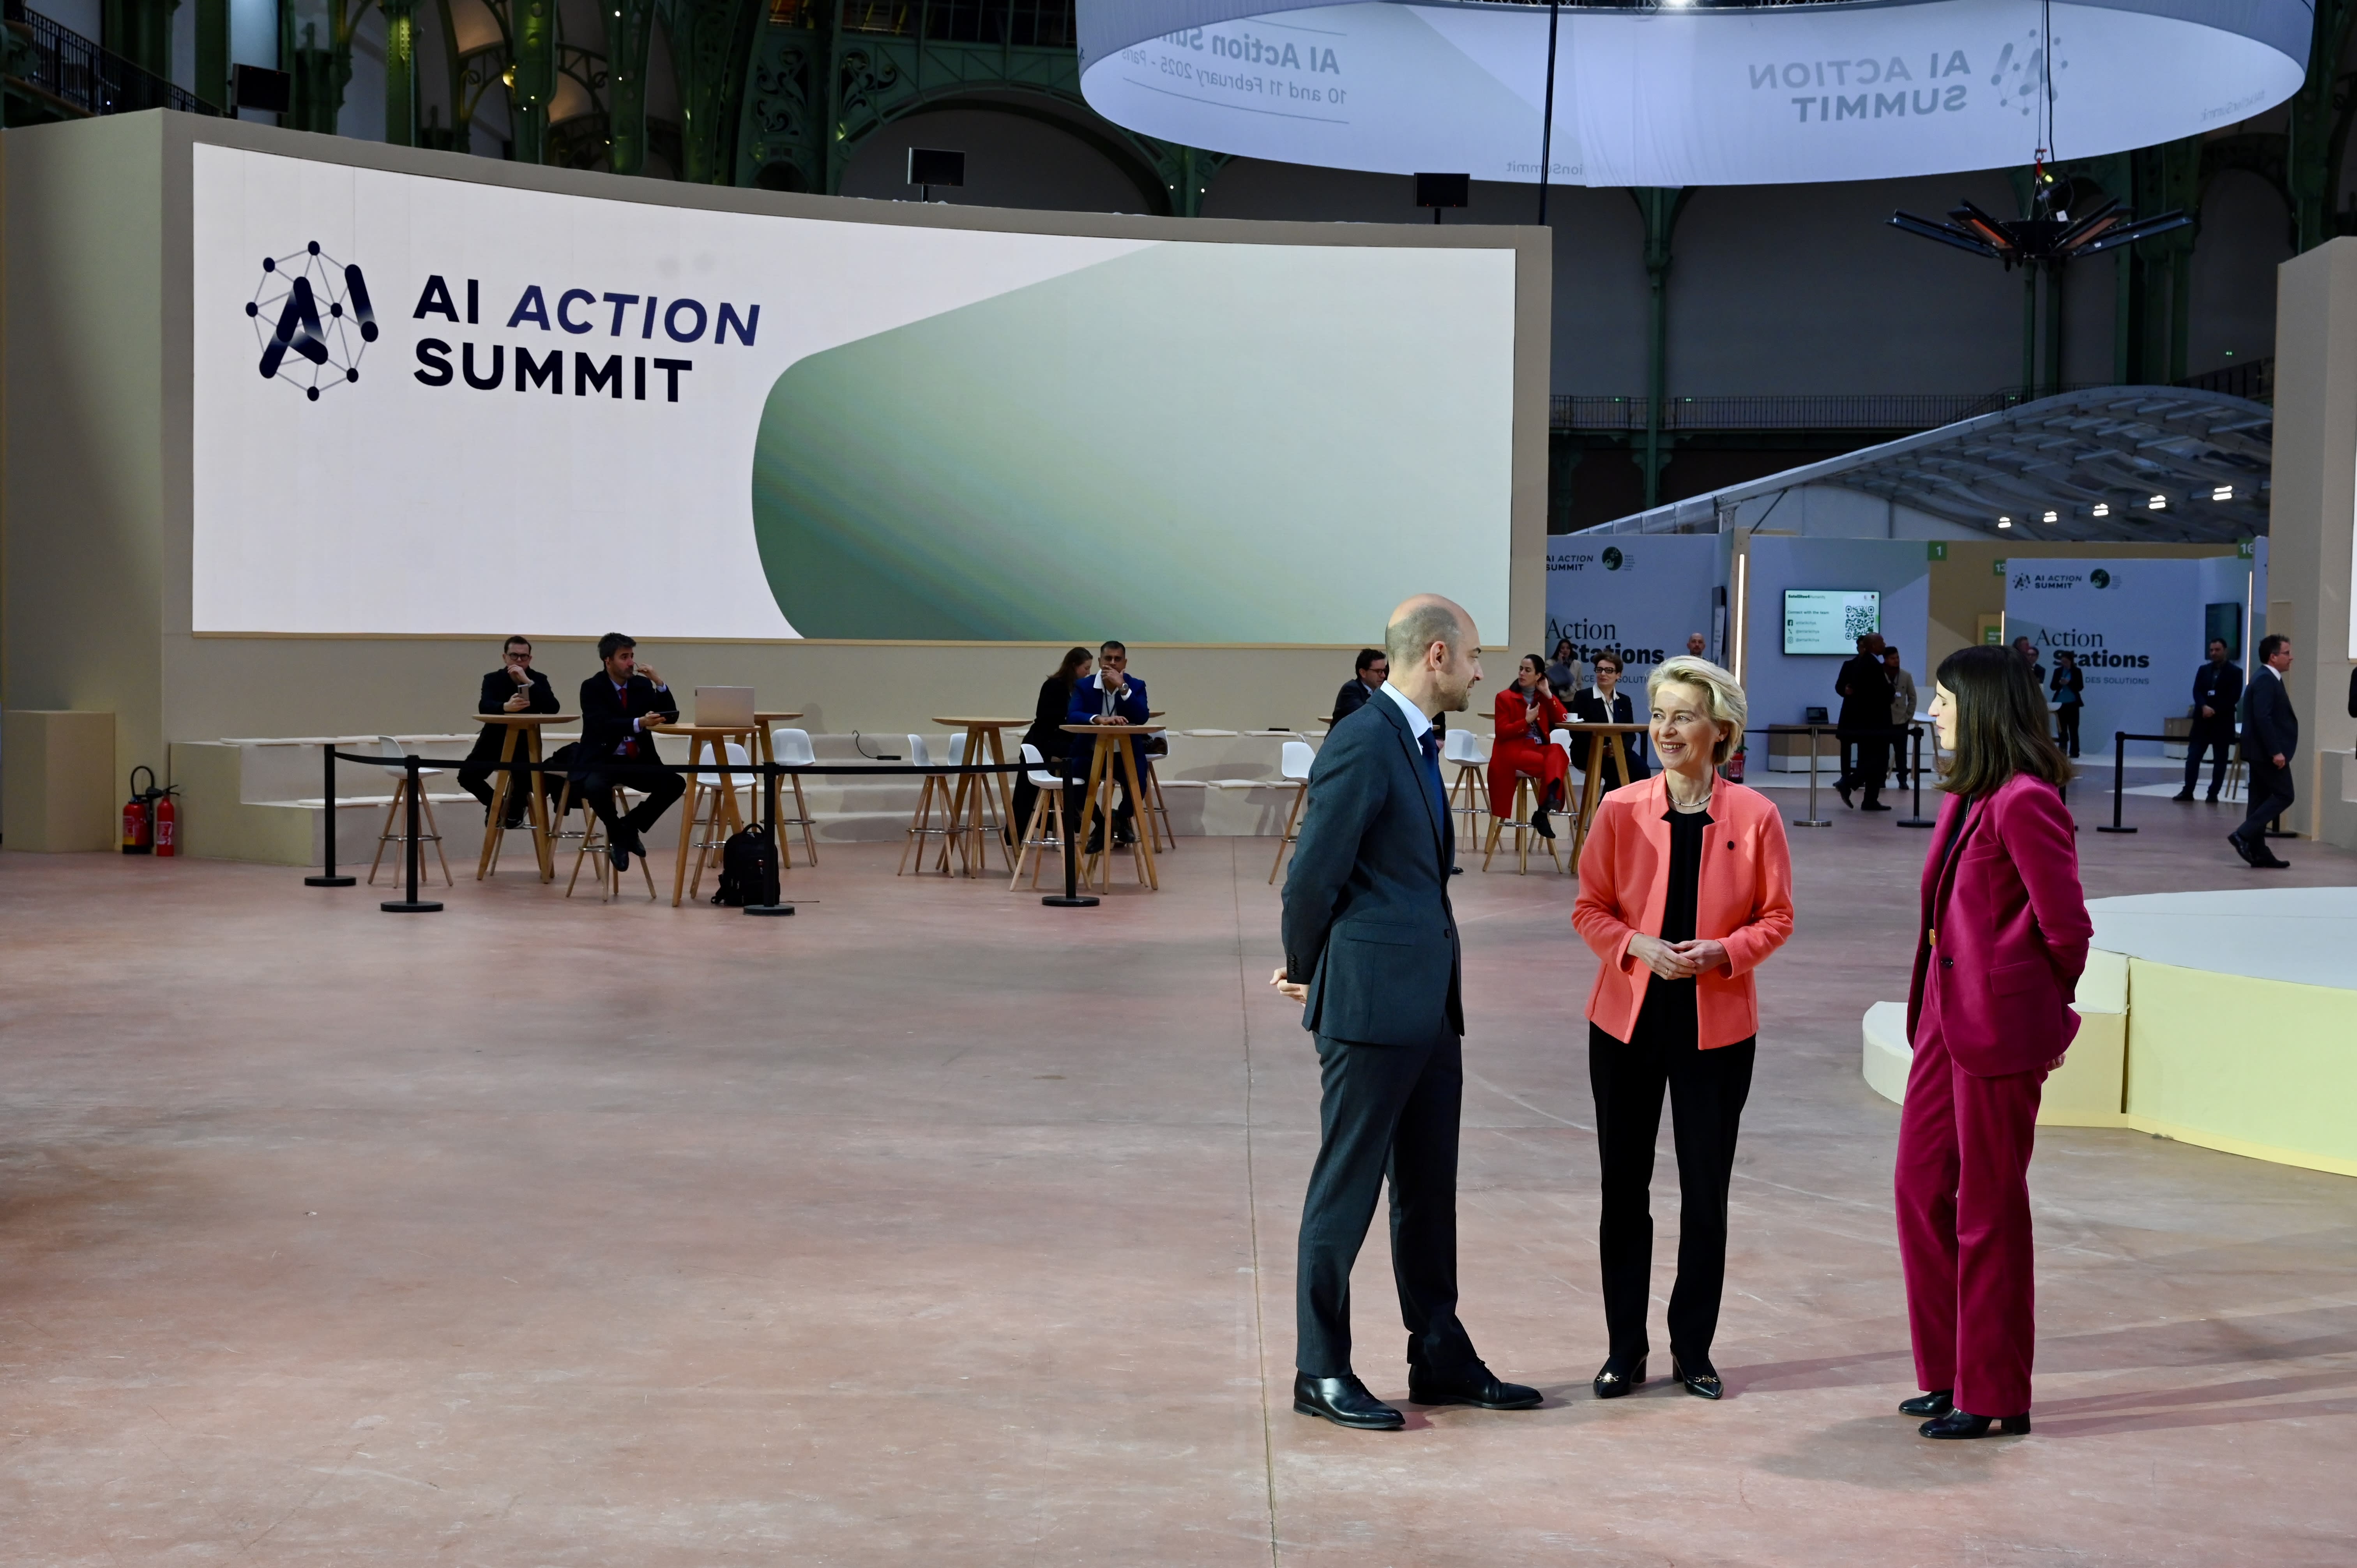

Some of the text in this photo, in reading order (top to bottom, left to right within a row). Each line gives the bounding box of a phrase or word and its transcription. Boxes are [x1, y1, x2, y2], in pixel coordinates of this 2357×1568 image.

[412, 274, 760, 347] AI ACTION
[413, 337, 693, 403] SUMMIT
[1936, 546, 1942, 556] 1
[1545, 618, 1616, 640] Action
[2035, 629, 2103, 647] Action
